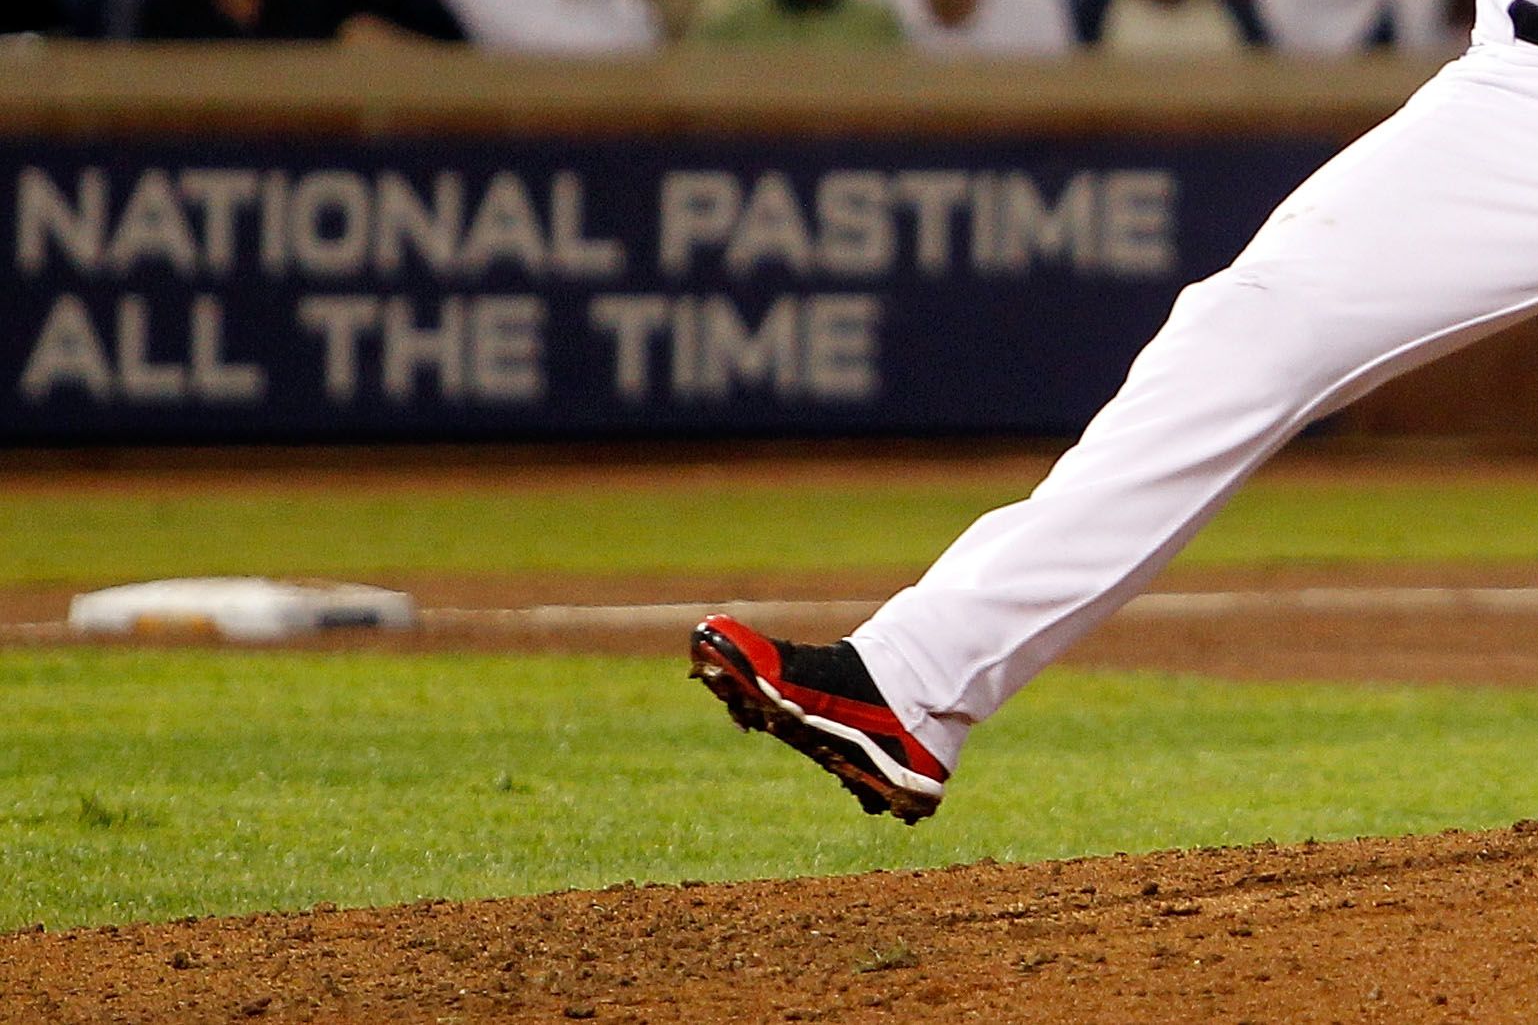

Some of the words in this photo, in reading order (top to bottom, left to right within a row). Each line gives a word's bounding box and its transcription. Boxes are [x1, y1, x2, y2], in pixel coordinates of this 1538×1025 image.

[14, 169, 624, 275] NATIONAL
[656, 171, 1177, 276] PASTIME
[20, 294, 268, 401] ALL
[299, 294, 547, 401] THE
[592, 294, 882, 401] TIME
